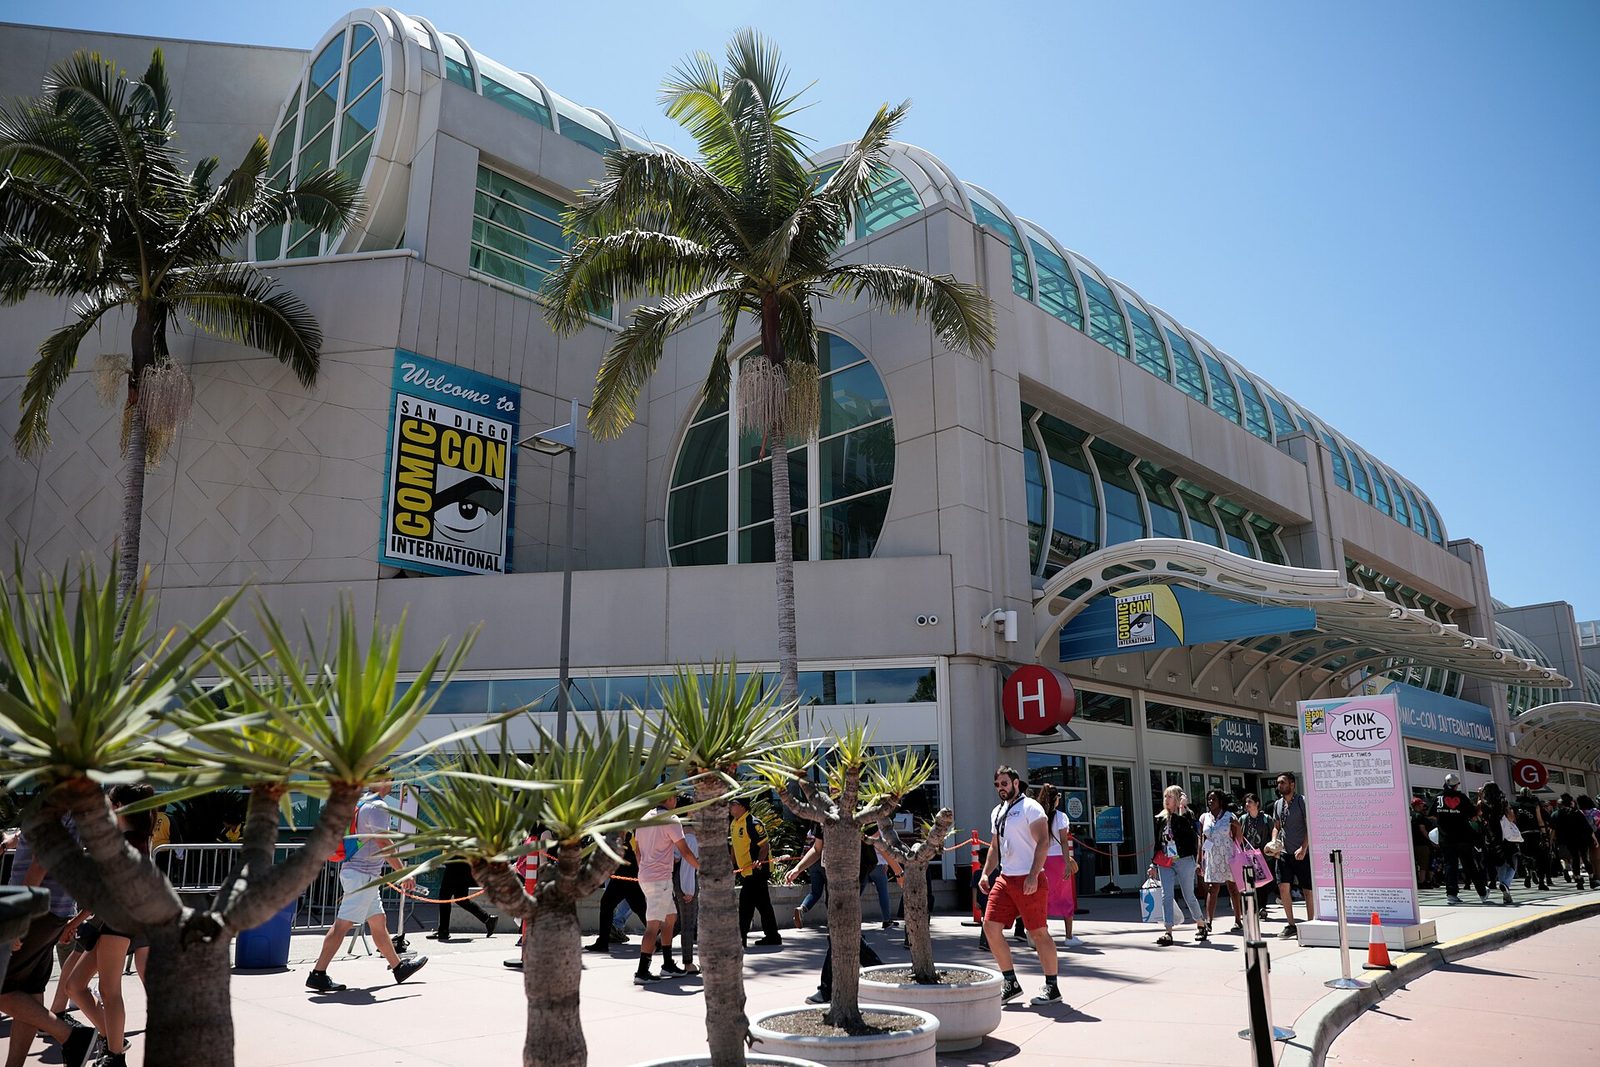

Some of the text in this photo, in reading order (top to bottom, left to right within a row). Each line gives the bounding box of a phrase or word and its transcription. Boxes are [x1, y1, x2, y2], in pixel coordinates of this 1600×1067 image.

[401, 362, 516, 412] Welcome to
[401, 400, 508, 441] SAN DIEGO
[440, 429, 506, 480] CON
[395, 419, 438, 537] COMIC
[391, 534, 502, 573] INTERNATIONAL
[1130, 600, 1150, 614] CON
[1118, 603, 1130, 640] COMIC
[1118, 637, 1153, 646] INTERNATIONAL
[1017, 678, 1046, 720] H
[1226, 720, 1244, 737] HALL
[1245, 723, 1251, 739] H
[1343, 712, 1376, 726] PINK
[1438, 714, 1494, 741] INTERNATIONAL
[1220, 737, 1259, 756] PROGRAMS
[1336, 727, 1387, 742] ROUTE
[1520, 765, 1540, 784] G
